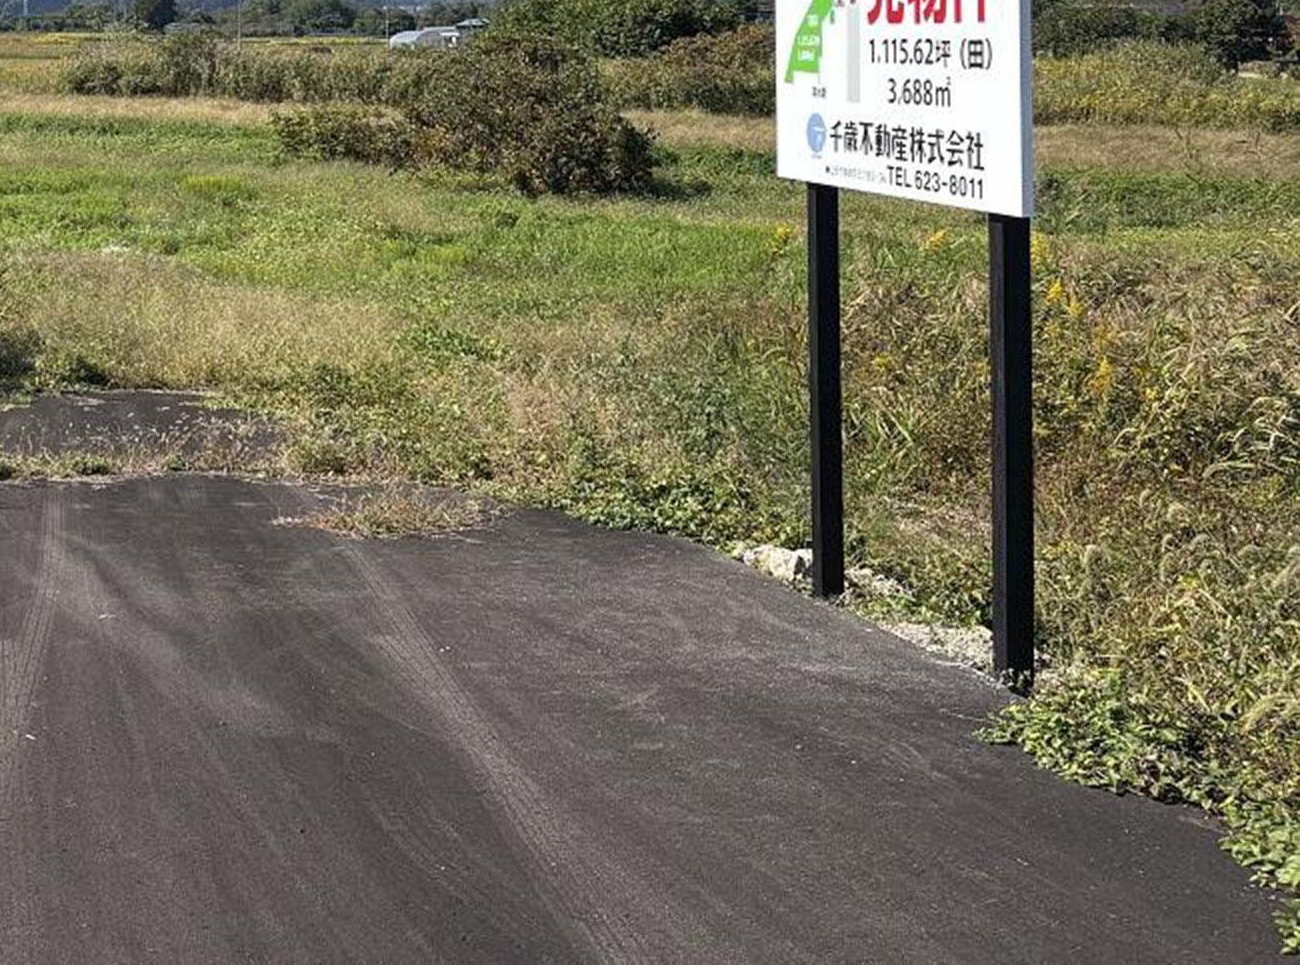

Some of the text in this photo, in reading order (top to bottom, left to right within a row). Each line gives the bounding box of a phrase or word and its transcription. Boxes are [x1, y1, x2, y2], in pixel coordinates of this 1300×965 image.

[830, 120, 985, 171] 千歳不動産株式会社
[887, 166, 912, 188] TEL
[915, 170, 983, 199] 623-8011
